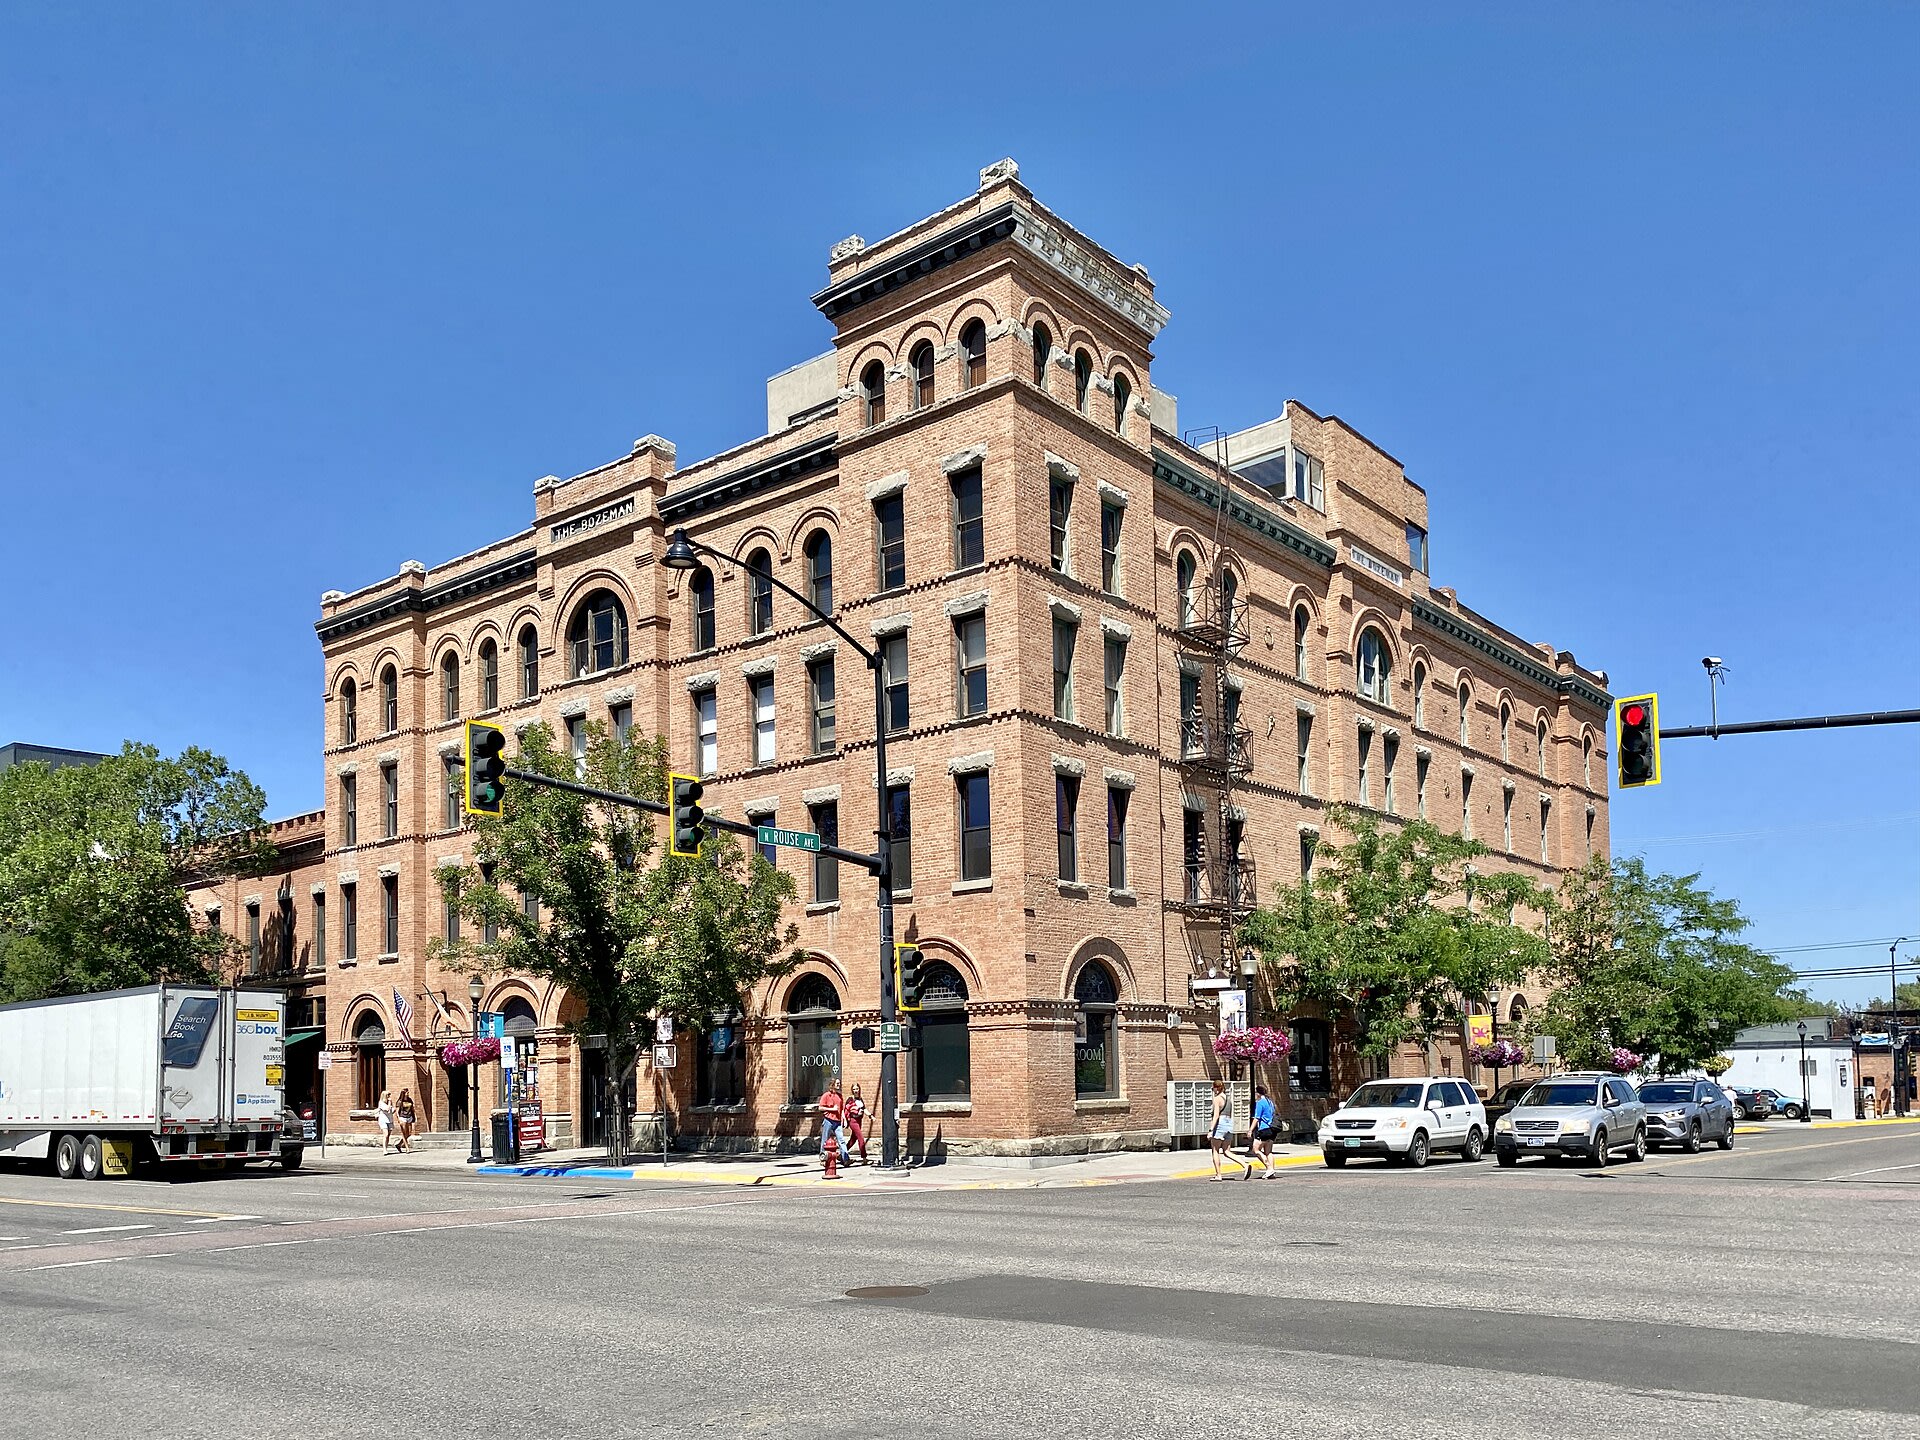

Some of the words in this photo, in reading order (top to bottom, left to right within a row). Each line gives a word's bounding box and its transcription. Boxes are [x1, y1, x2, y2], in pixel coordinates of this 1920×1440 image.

[556, 523, 576, 540] THE
[581, 502, 634, 531] BOZEMAN
[764, 831, 769, 842] N
[773, 831, 800, 846] ROUSE
[803, 838, 815, 849] AVE
